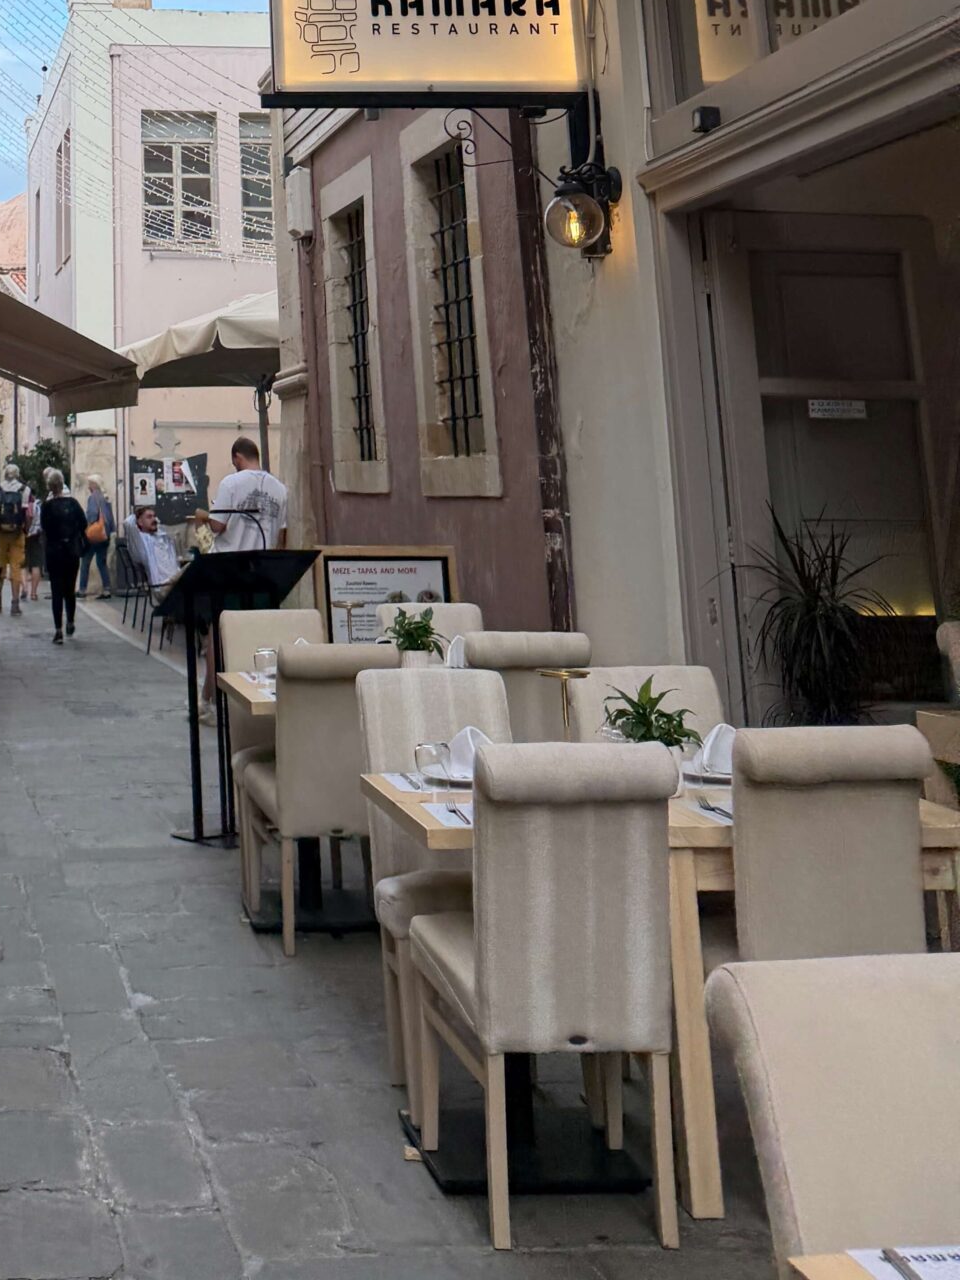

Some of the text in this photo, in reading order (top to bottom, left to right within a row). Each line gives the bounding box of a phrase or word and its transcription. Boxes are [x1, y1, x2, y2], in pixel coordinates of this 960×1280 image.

[372, 23, 560, 35] RESTAURANT
[332, 567, 351, 575] MEZE
[357, 567, 378, 575] TAPAS
[380, 567, 395, 575] AND
[397, 567, 418, 575] MORE
